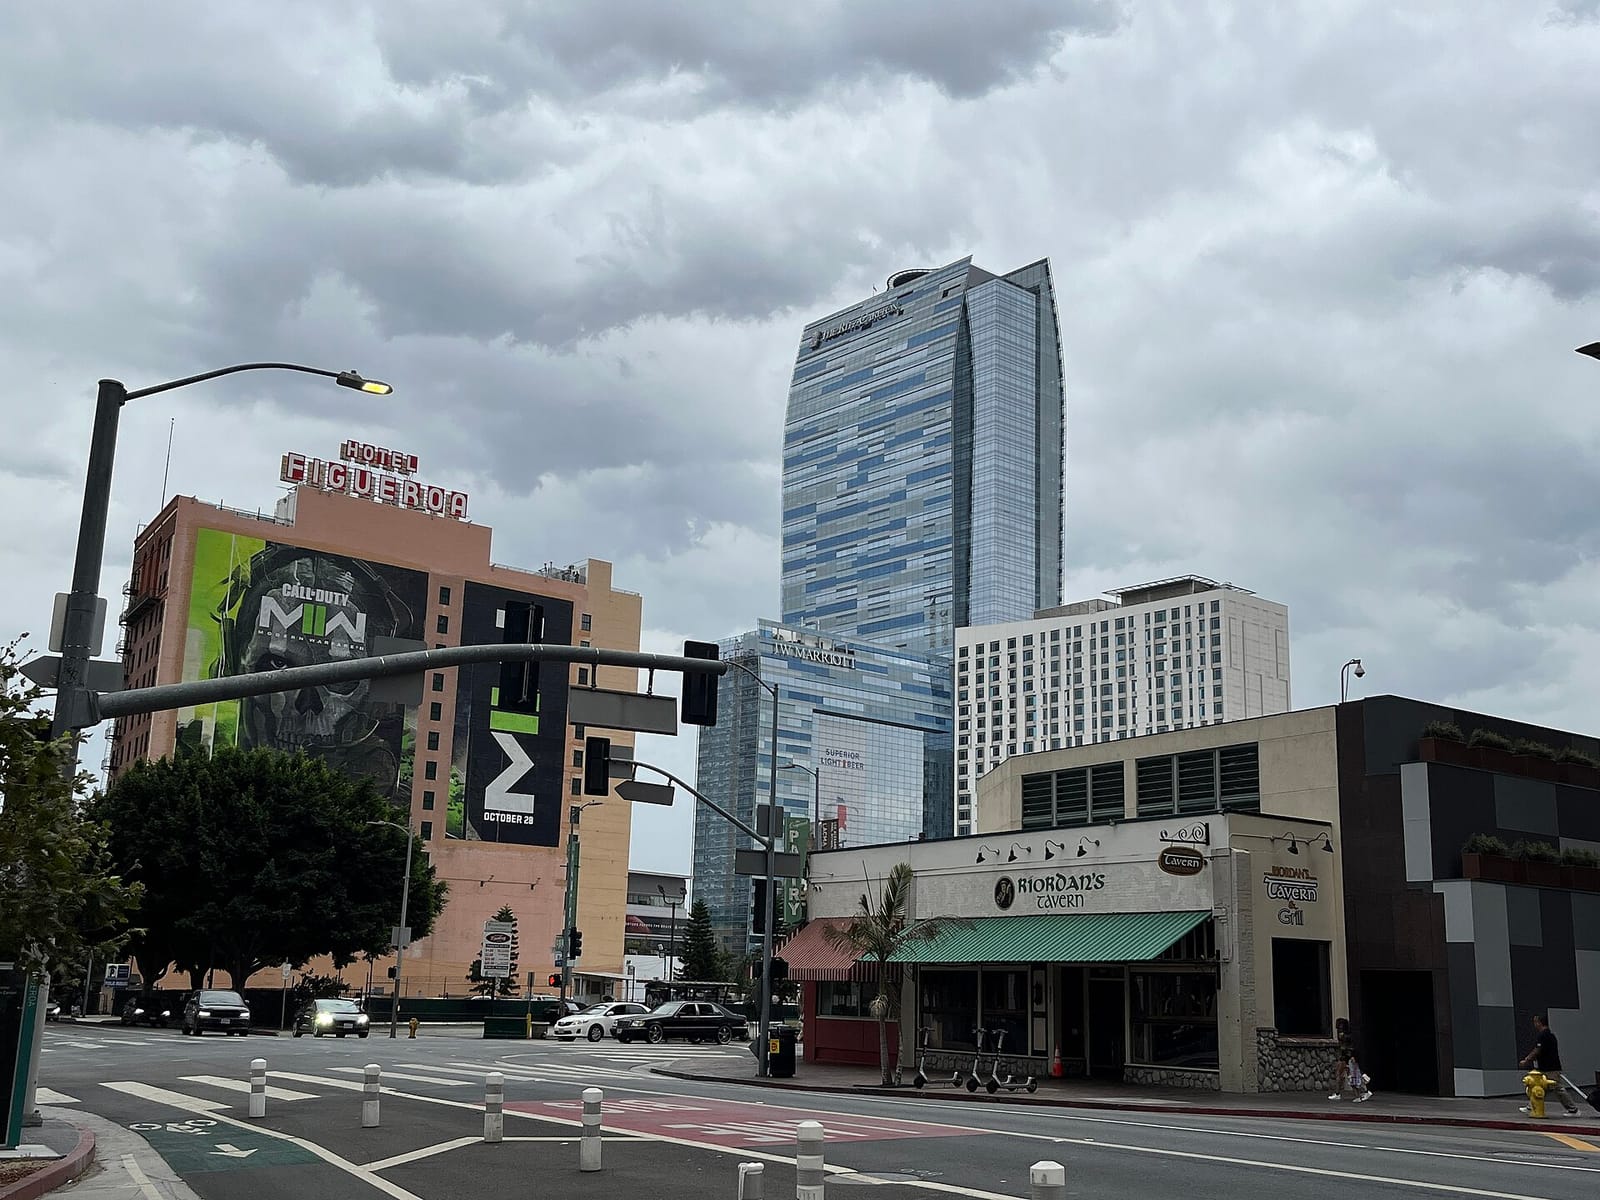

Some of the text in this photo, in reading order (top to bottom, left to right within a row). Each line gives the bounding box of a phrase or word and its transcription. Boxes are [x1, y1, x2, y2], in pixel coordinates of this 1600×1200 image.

[346, 439, 419, 474] HOTEL
[286, 451, 468, 518] FIGUEROA
[281, 583, 349, 607] CALL DUTY
[773, 642, 856, 669] JW MARRIOTT
[820, 757, 865, 771] LIGHT BEER
[825, 748, 860, 760] SUPERIOR
[483, 811, 534, 825] OCTOBER 28
[1017, 872, 1106, 894] RIORDAN'S
[1278, 908, 1304, 926] Grill
